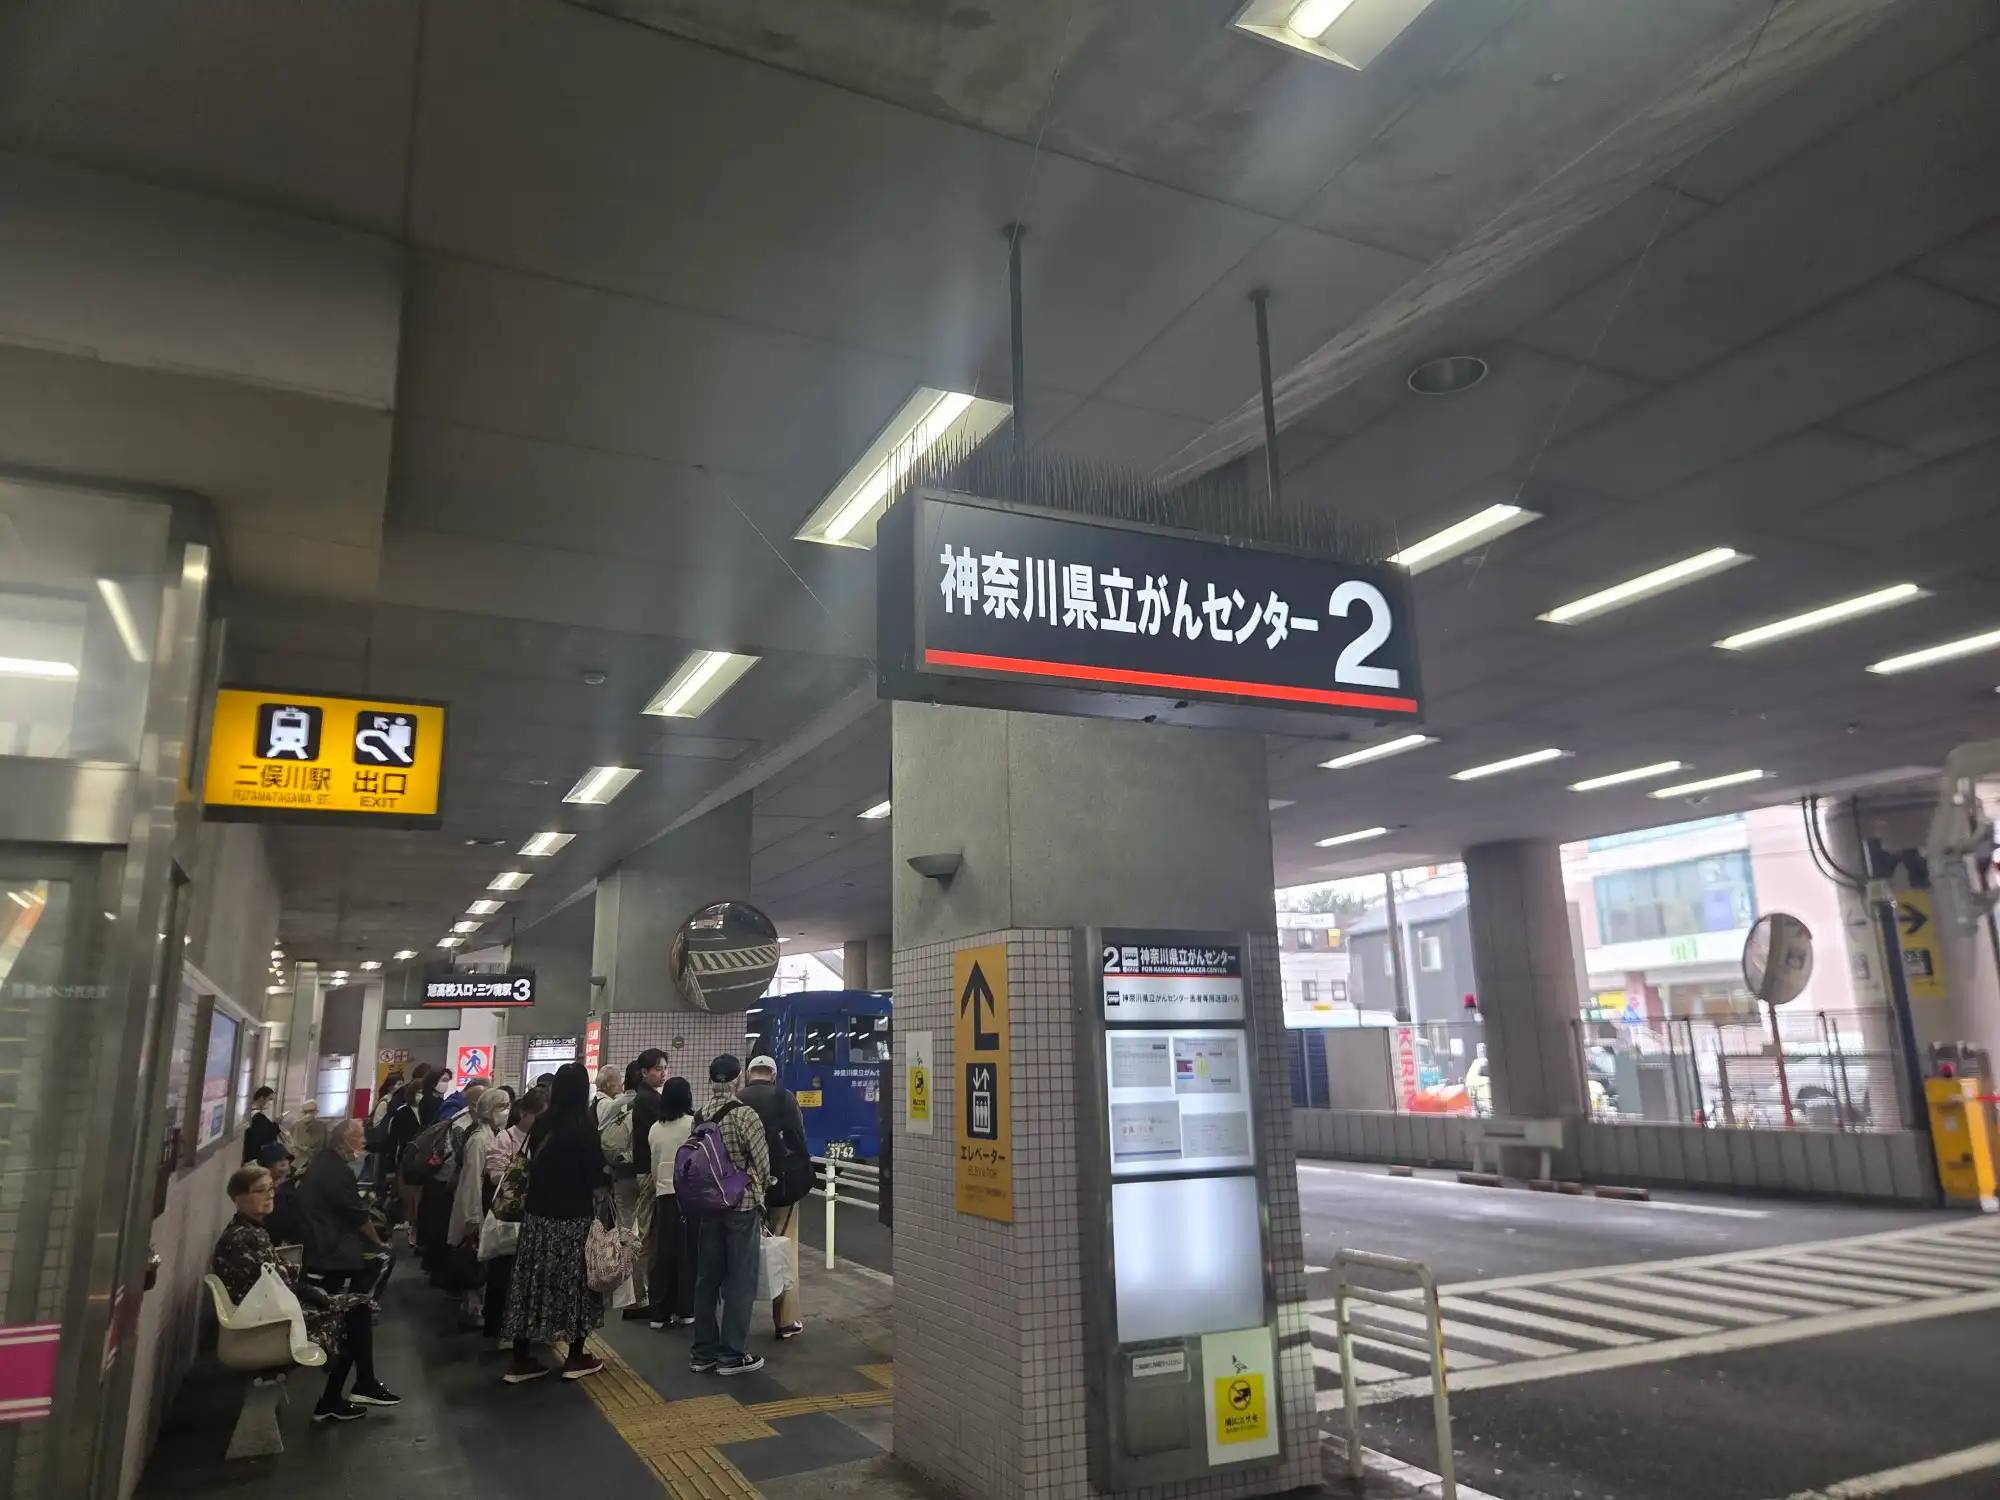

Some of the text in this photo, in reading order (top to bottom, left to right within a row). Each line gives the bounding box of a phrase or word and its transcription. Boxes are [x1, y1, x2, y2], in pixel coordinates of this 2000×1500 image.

[940, 544, 1400, 689] 神奈川県立がんセンター 2
[234, 764, 332, 791] 二俣川駅
[353, 770, 408, 796] 出口
[360, 796, 398, 809] EXIT
[1103, 946, 1236, 973] 2 神奈川県立がんセンター
[513, 979, 531, 1001] 3
[960, 1144, 1006, 1165] エレベーター
